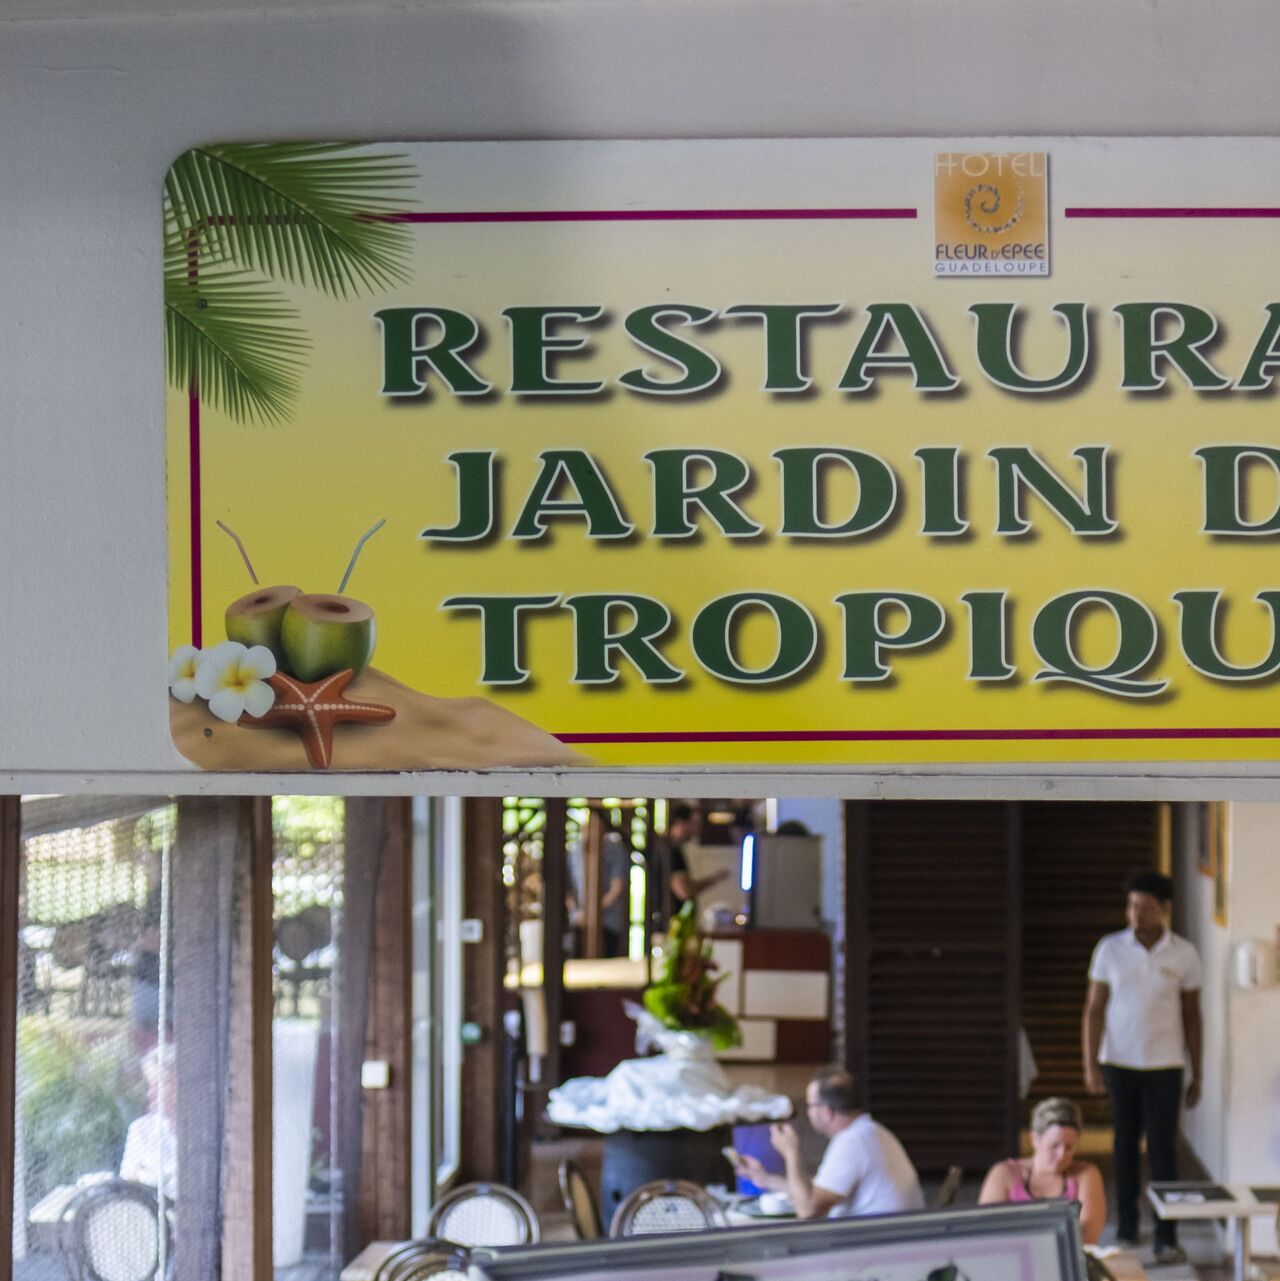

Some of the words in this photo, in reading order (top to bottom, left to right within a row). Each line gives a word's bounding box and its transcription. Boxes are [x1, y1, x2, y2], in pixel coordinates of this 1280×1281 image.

[935, 153, 1044, 177] HOTEL
[935, 243, 989, 260] FLEUR
[934, 262, 1046, 273] GUADELOUPE
[419, 446, 1119, 541] JARDIN
